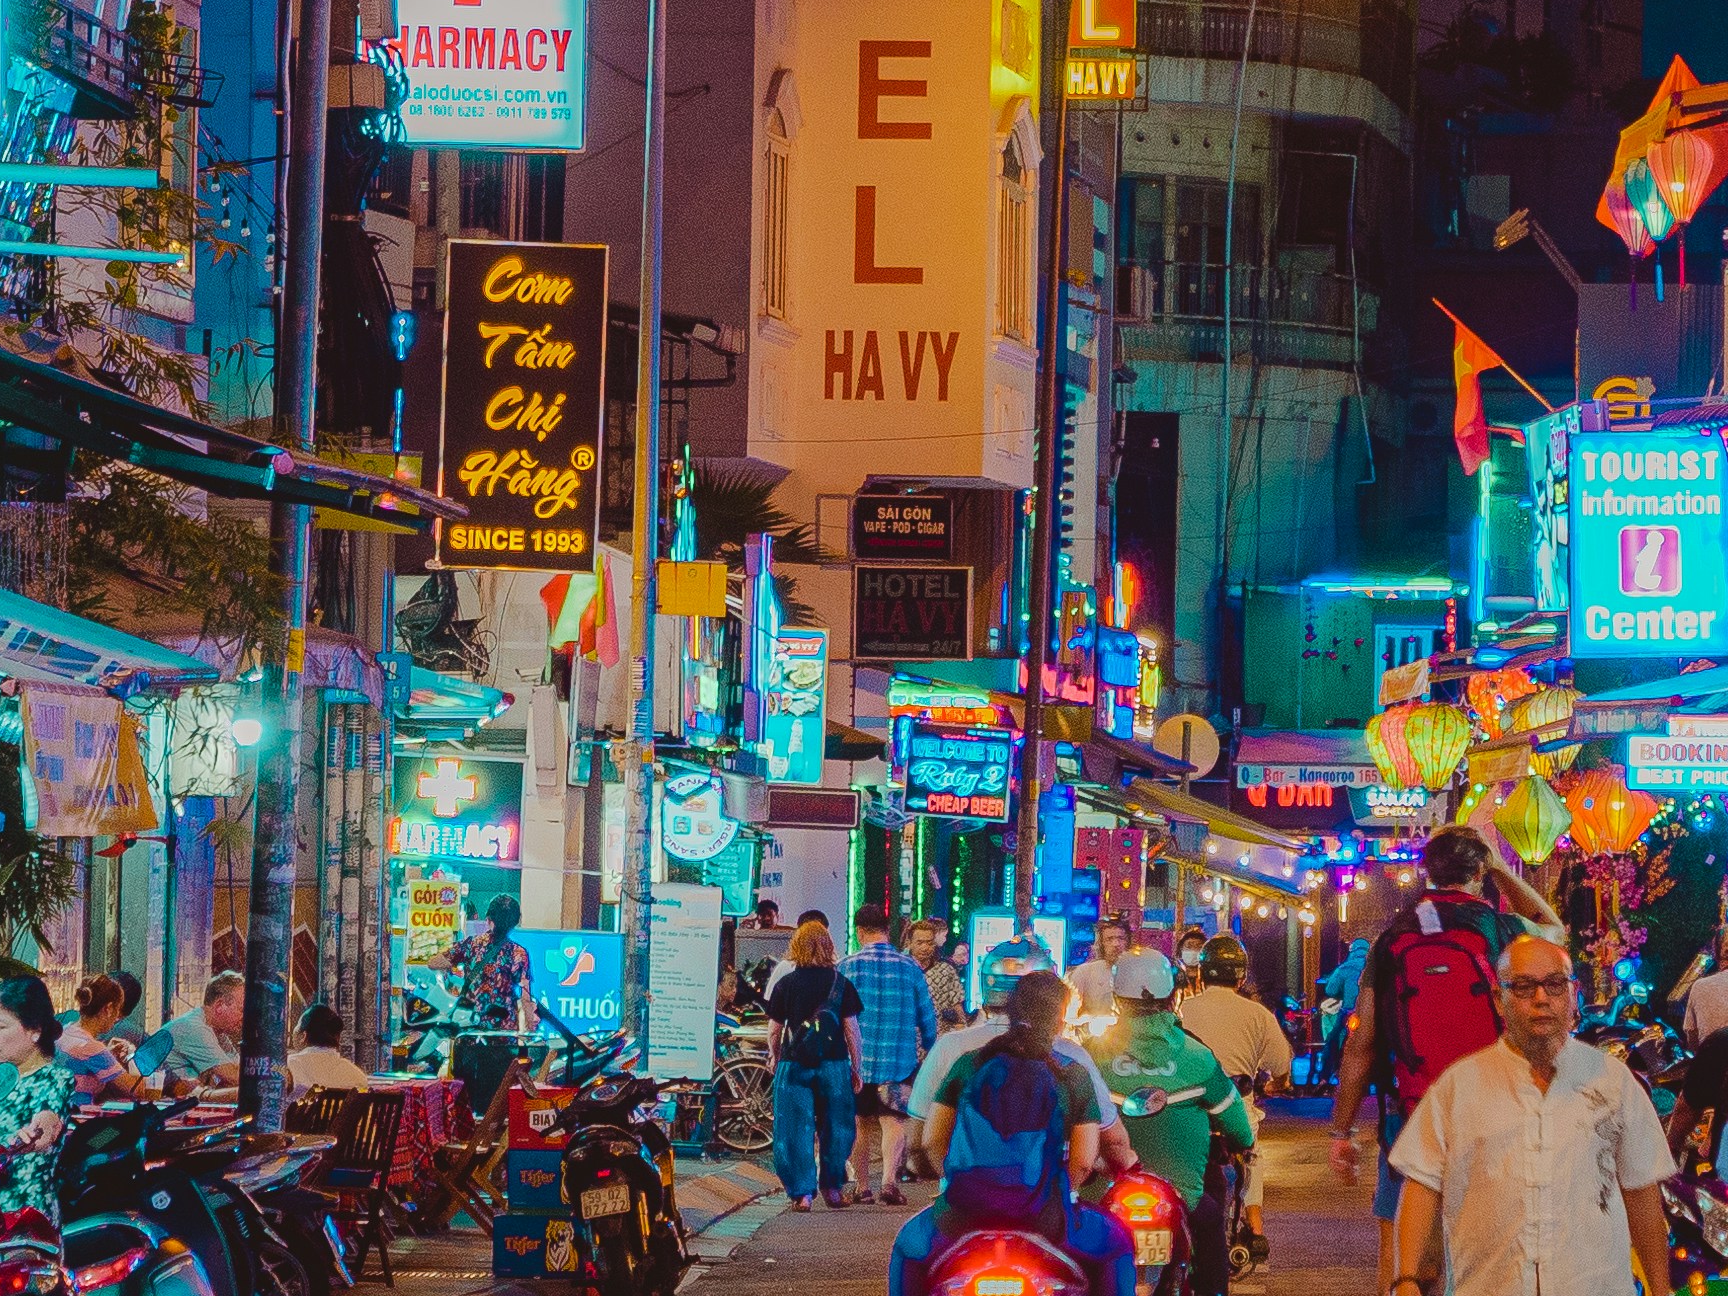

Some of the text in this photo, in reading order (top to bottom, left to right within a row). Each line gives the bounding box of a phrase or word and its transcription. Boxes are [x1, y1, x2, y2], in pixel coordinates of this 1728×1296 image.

[362, 25, 572, 72] HARMACY
[482, 256, 573, 304] Cơm
[479, 322, 575, 369] Tấm
[485, 386, 567, 442] Chị
[1582, 450, 1720, 481] TOURIST
[451, 527, 585, 554] SINCE 1993
[864, 522, 944, 534] VAPE POD CIGAR
[865, 574, 959, 597] HOTEL
[1586, 606, 1716, 640] Center
[912, 738, 1008, 763] WELCOME TO
[1263, 768, 1285, 783] Bar
[1358, 769, 1377, 783] 165
[1636, 769, 1684, 784] BEST
[927, 794, 1003, 816] CHEAP BEER
[412, 907, 454, 927] CUỐN
[532, 1113, 552, 1127] BIA
